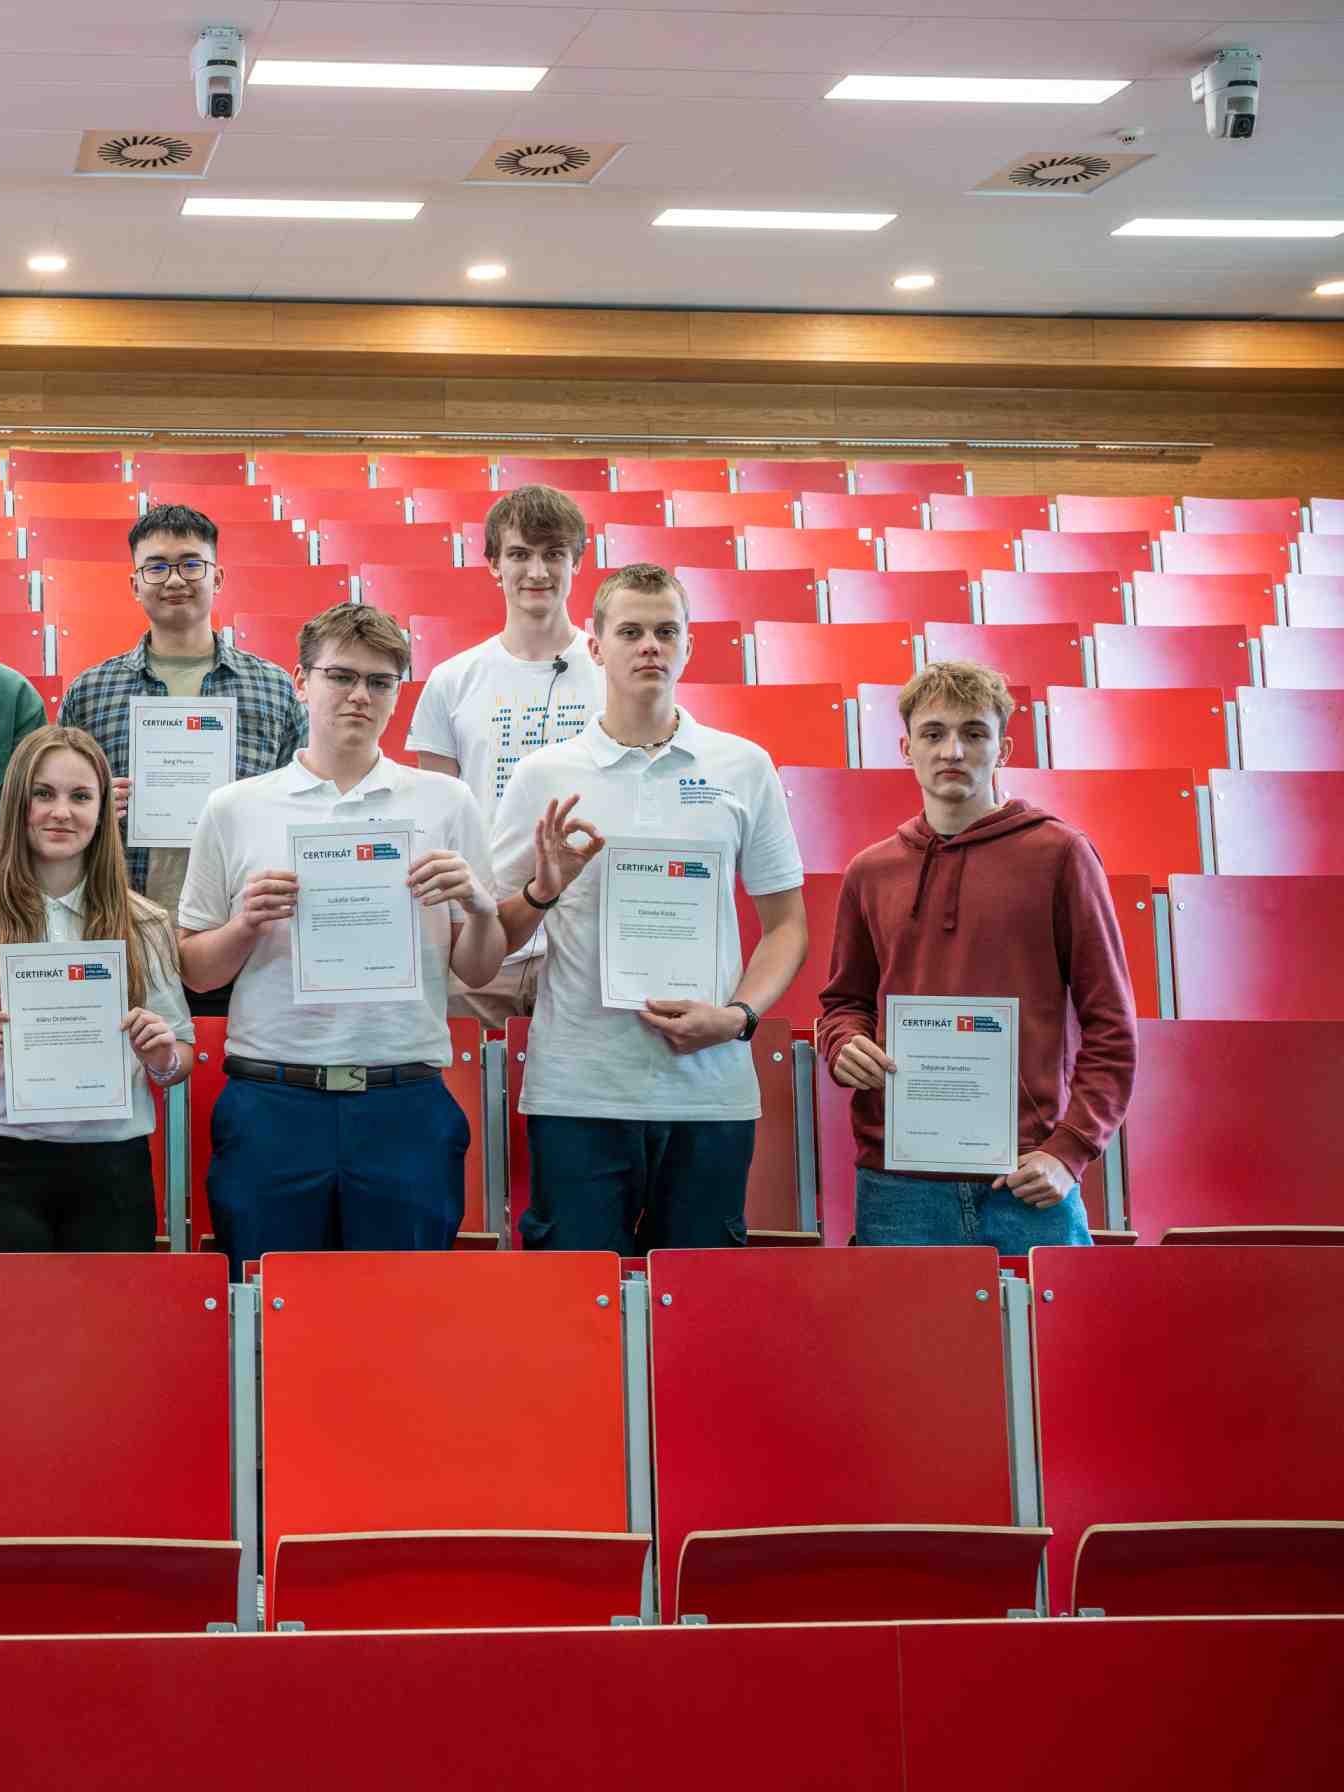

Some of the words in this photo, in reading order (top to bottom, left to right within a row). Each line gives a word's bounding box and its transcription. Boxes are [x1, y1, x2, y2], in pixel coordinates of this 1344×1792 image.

[303, 848, 352, 859] CERTIFIKÁT
[616, 863, 664, 873] CERTIFIKÁT
[15, 968, 64, 979] CERTIFIKÁT
[902, 1017, 952, 1027] CERTIFIKÁT
